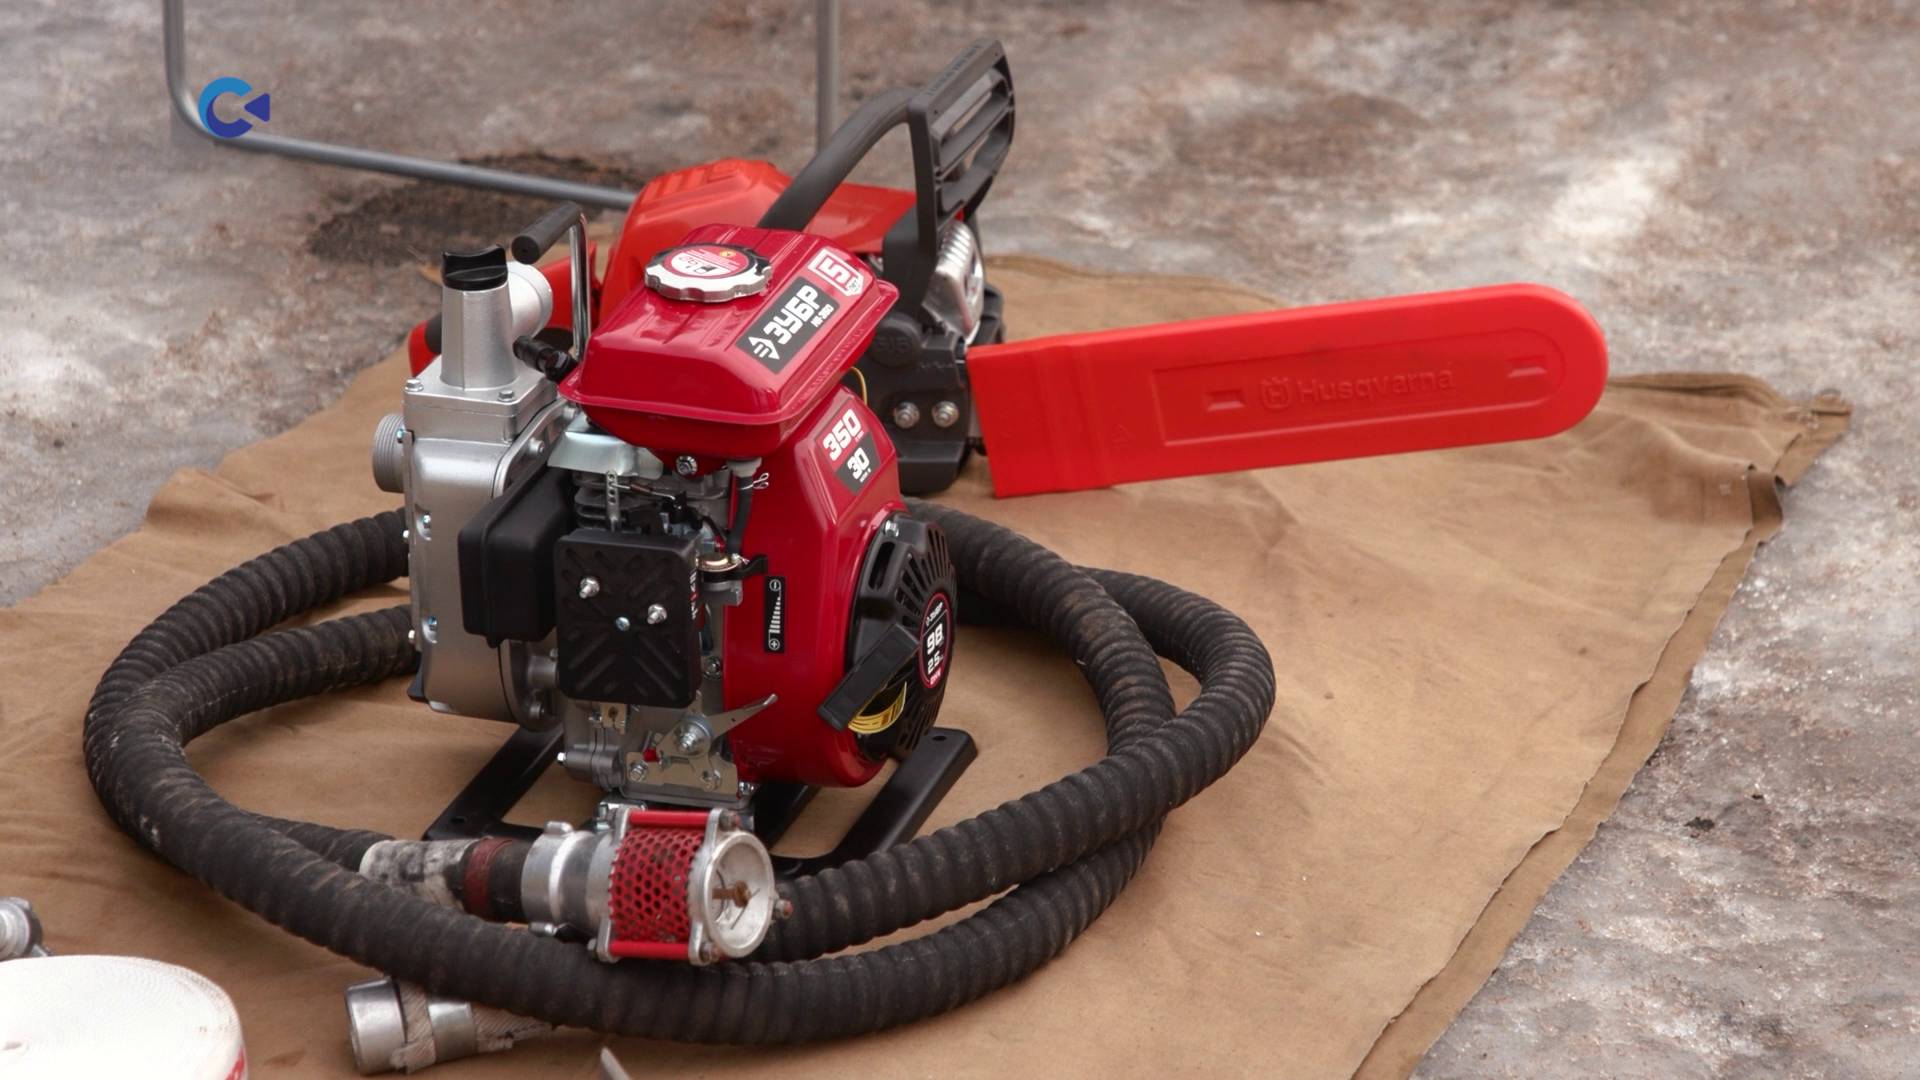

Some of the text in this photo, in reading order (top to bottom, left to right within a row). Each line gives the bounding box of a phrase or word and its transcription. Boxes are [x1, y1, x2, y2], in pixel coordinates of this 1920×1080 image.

[819, 258, 851, 284] 5
[763, 285, 820, 345] ЗУБР
[1299, 369, 1456, 405] Husqvarna
[823, 409, 862, 462] 350
[847, 447, 870, 480] 30
[927, 623, 944, 655] 98
